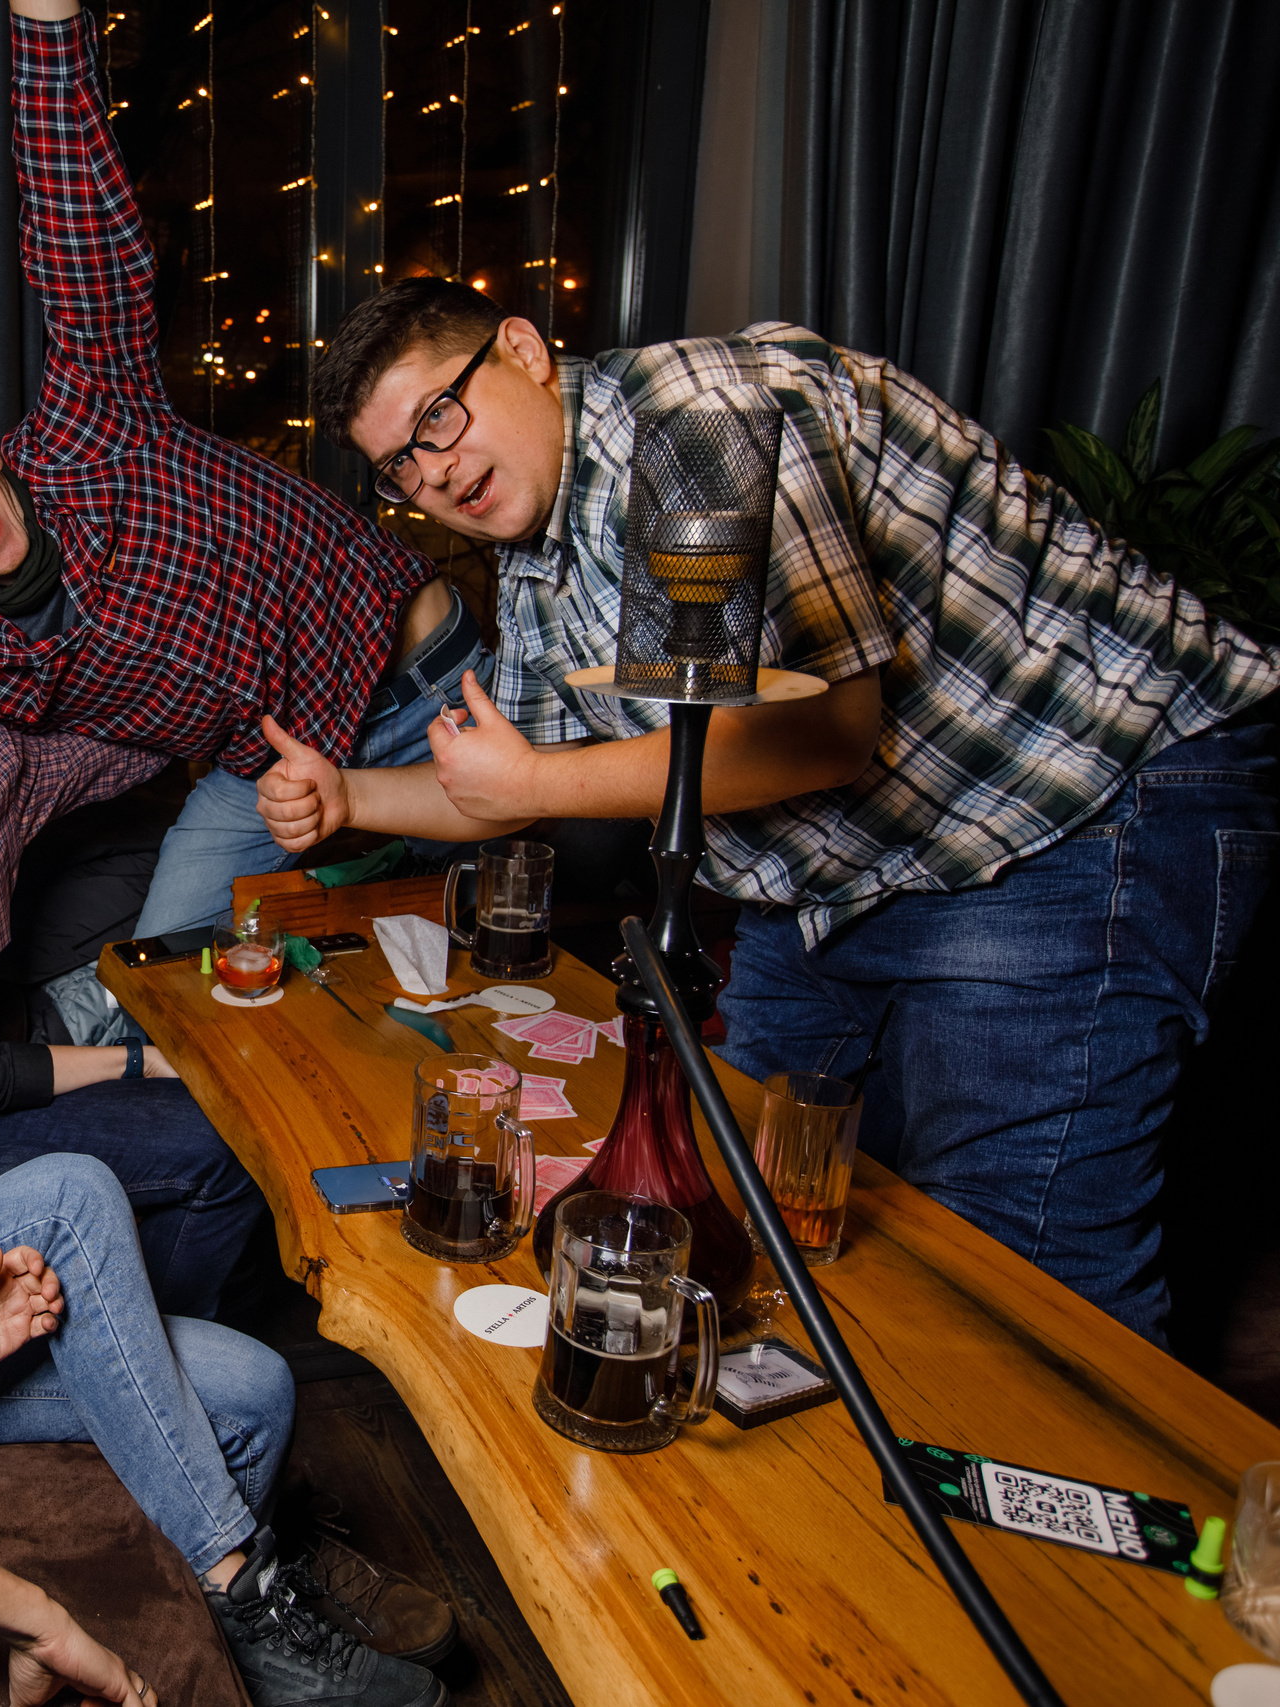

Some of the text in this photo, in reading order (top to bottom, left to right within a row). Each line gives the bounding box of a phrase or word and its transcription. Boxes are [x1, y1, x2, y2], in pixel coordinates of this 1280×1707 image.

[484, 1296, 537, 1334] STELLA ARTOIS
[1102, 1490, 1148, 1559] МЕНЮ
